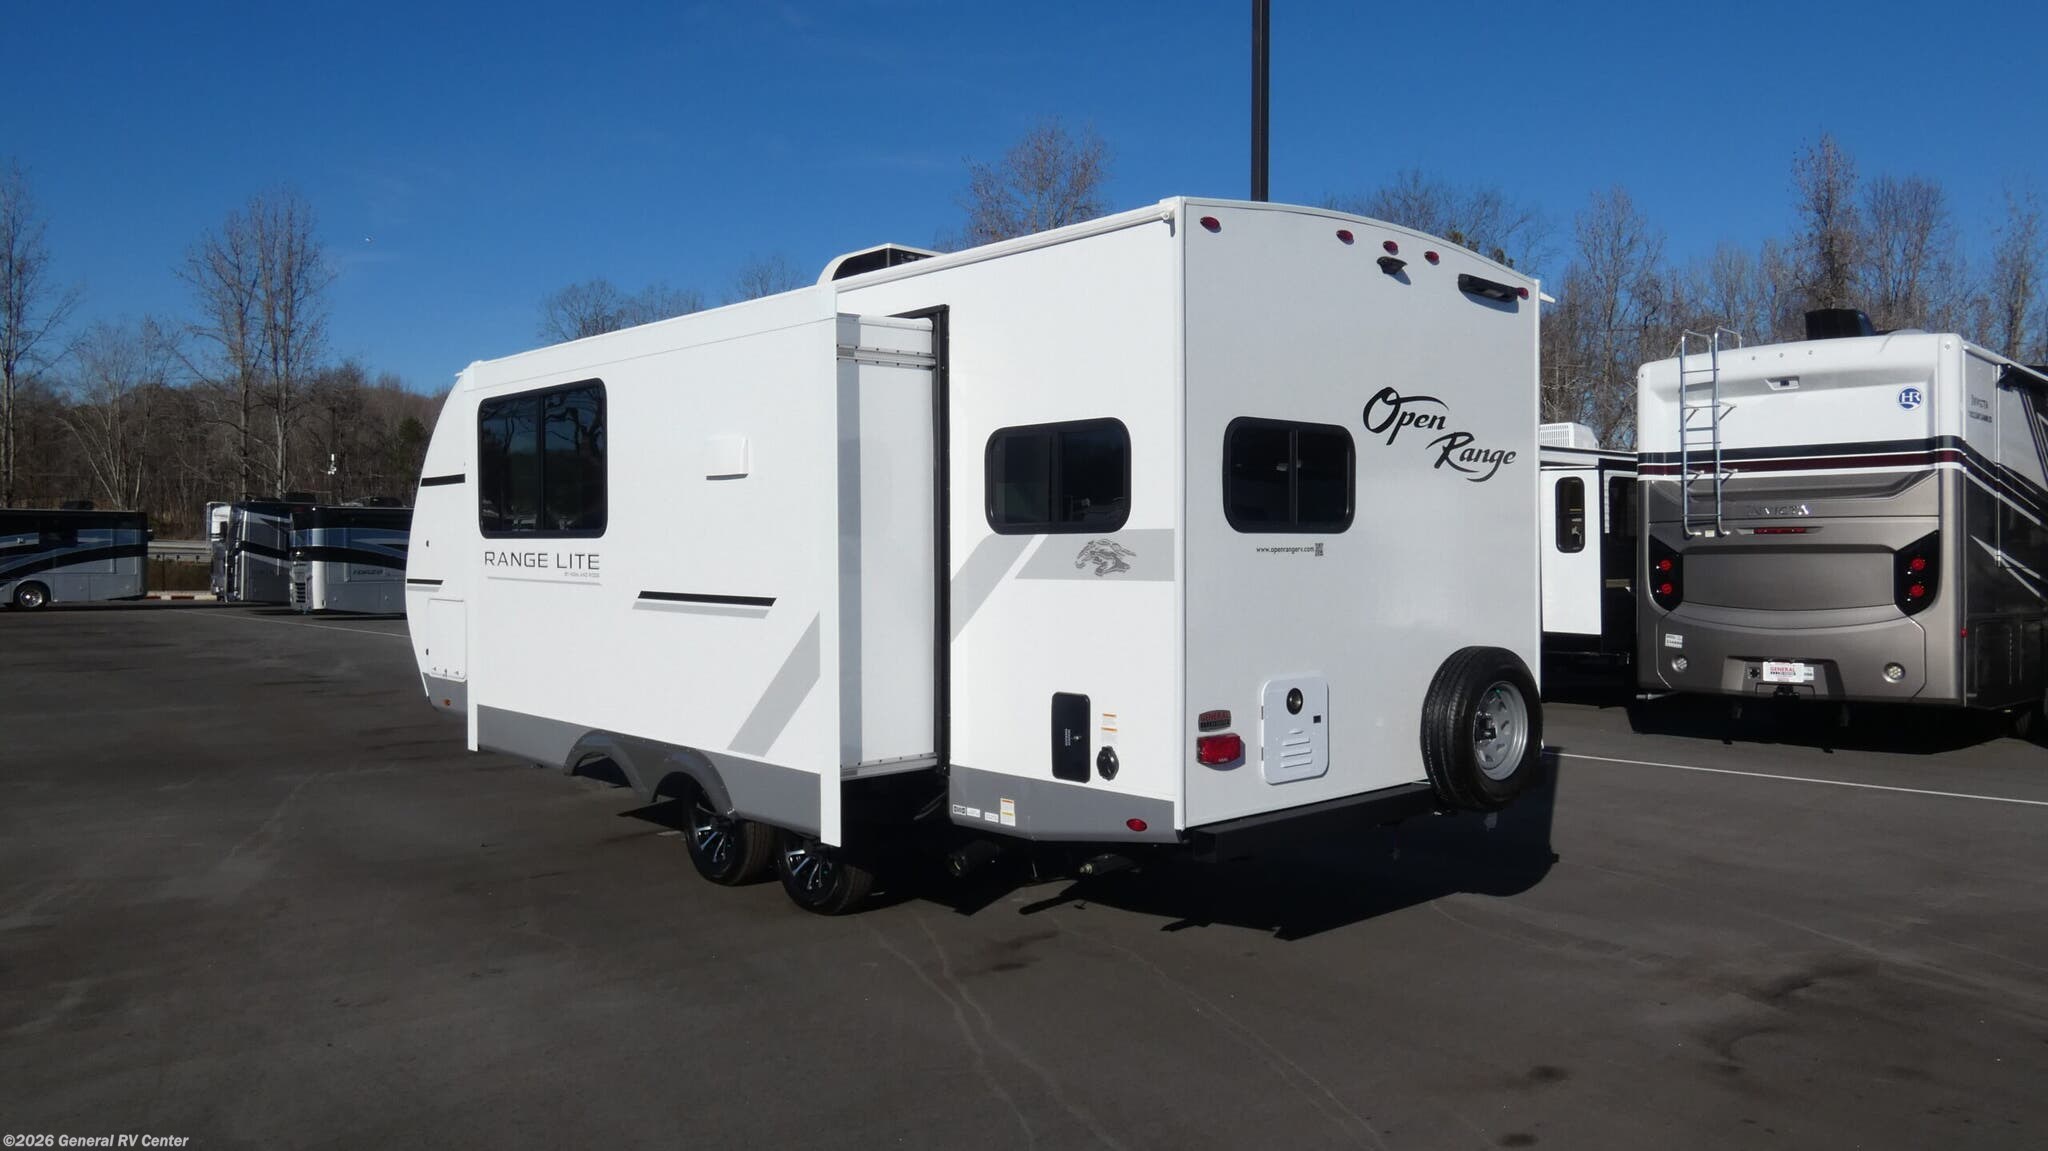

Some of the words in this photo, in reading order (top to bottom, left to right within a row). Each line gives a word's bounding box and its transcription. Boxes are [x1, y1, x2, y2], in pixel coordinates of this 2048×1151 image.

[1363, 387, 1449, 446] Open
[1425, 431, 1517, 483] Range
[484, 551, 549, 569] RANGE
[556, 553, 600, 570] LITE
